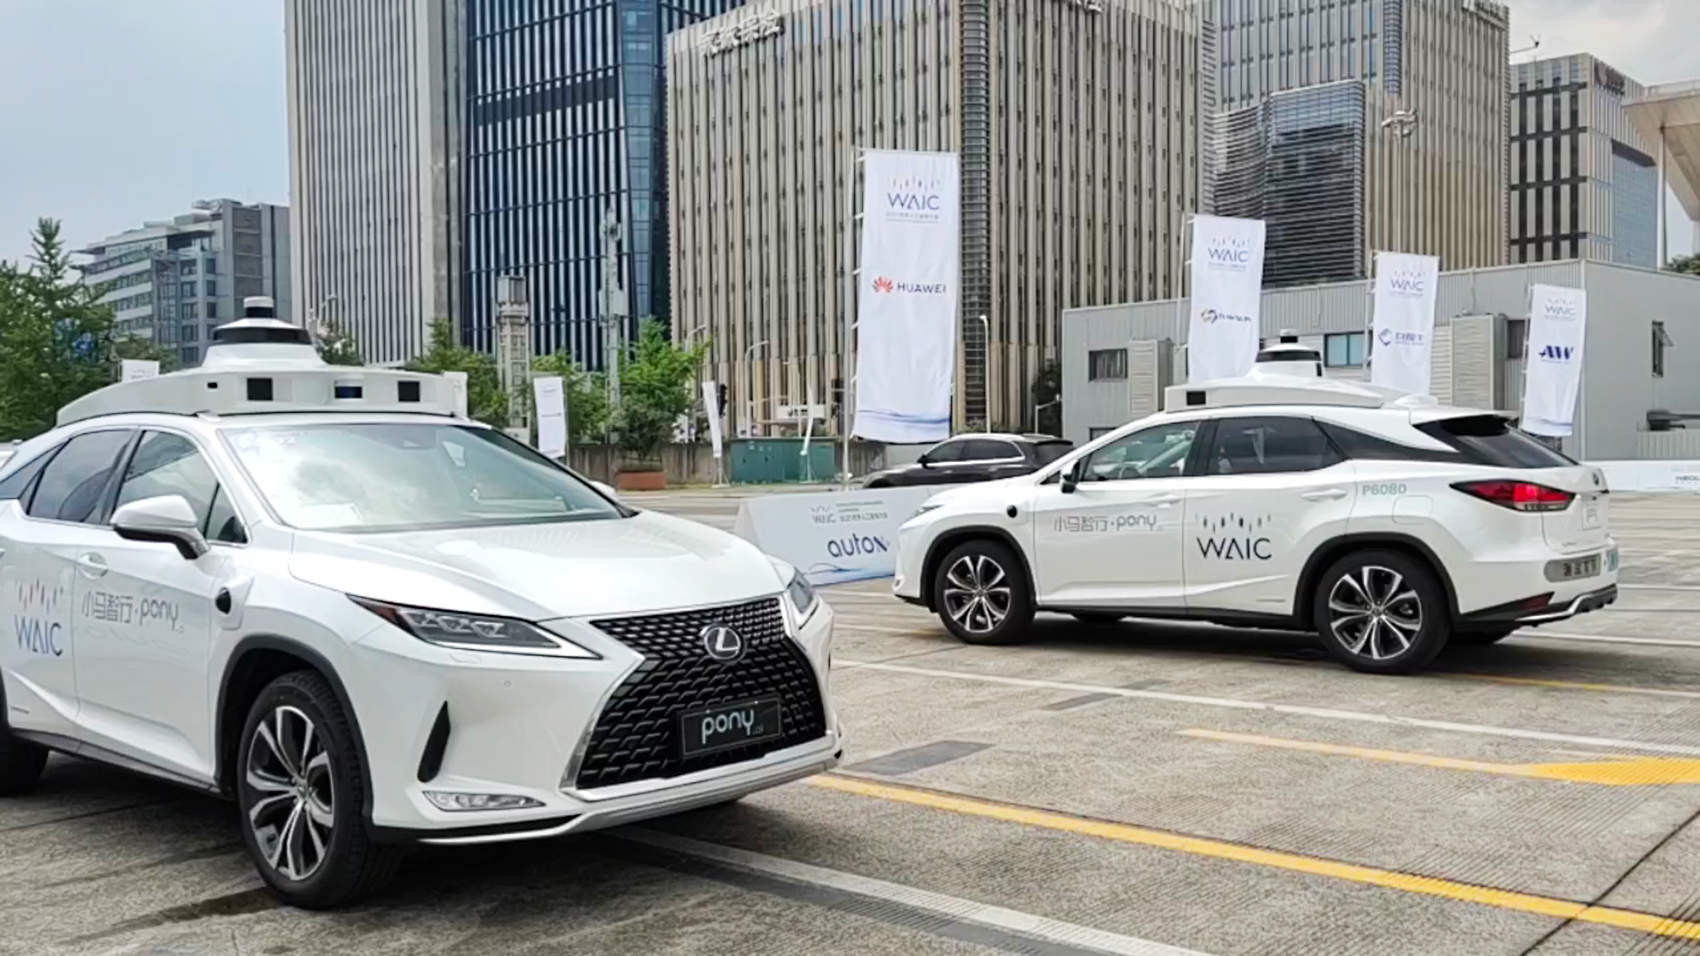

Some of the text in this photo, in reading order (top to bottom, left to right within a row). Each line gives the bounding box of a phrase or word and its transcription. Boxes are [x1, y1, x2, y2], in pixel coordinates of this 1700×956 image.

[887, 193, 940, 211] WAIC
[1207, 248, 1249, 262] WAIC
[897, 282, 947, 293] HUAWEI
[1362, 483, 1408, 496] P6080
[1196, 537, 1273, 560] WAIC
[14, 614, 63, 657] WAIC
